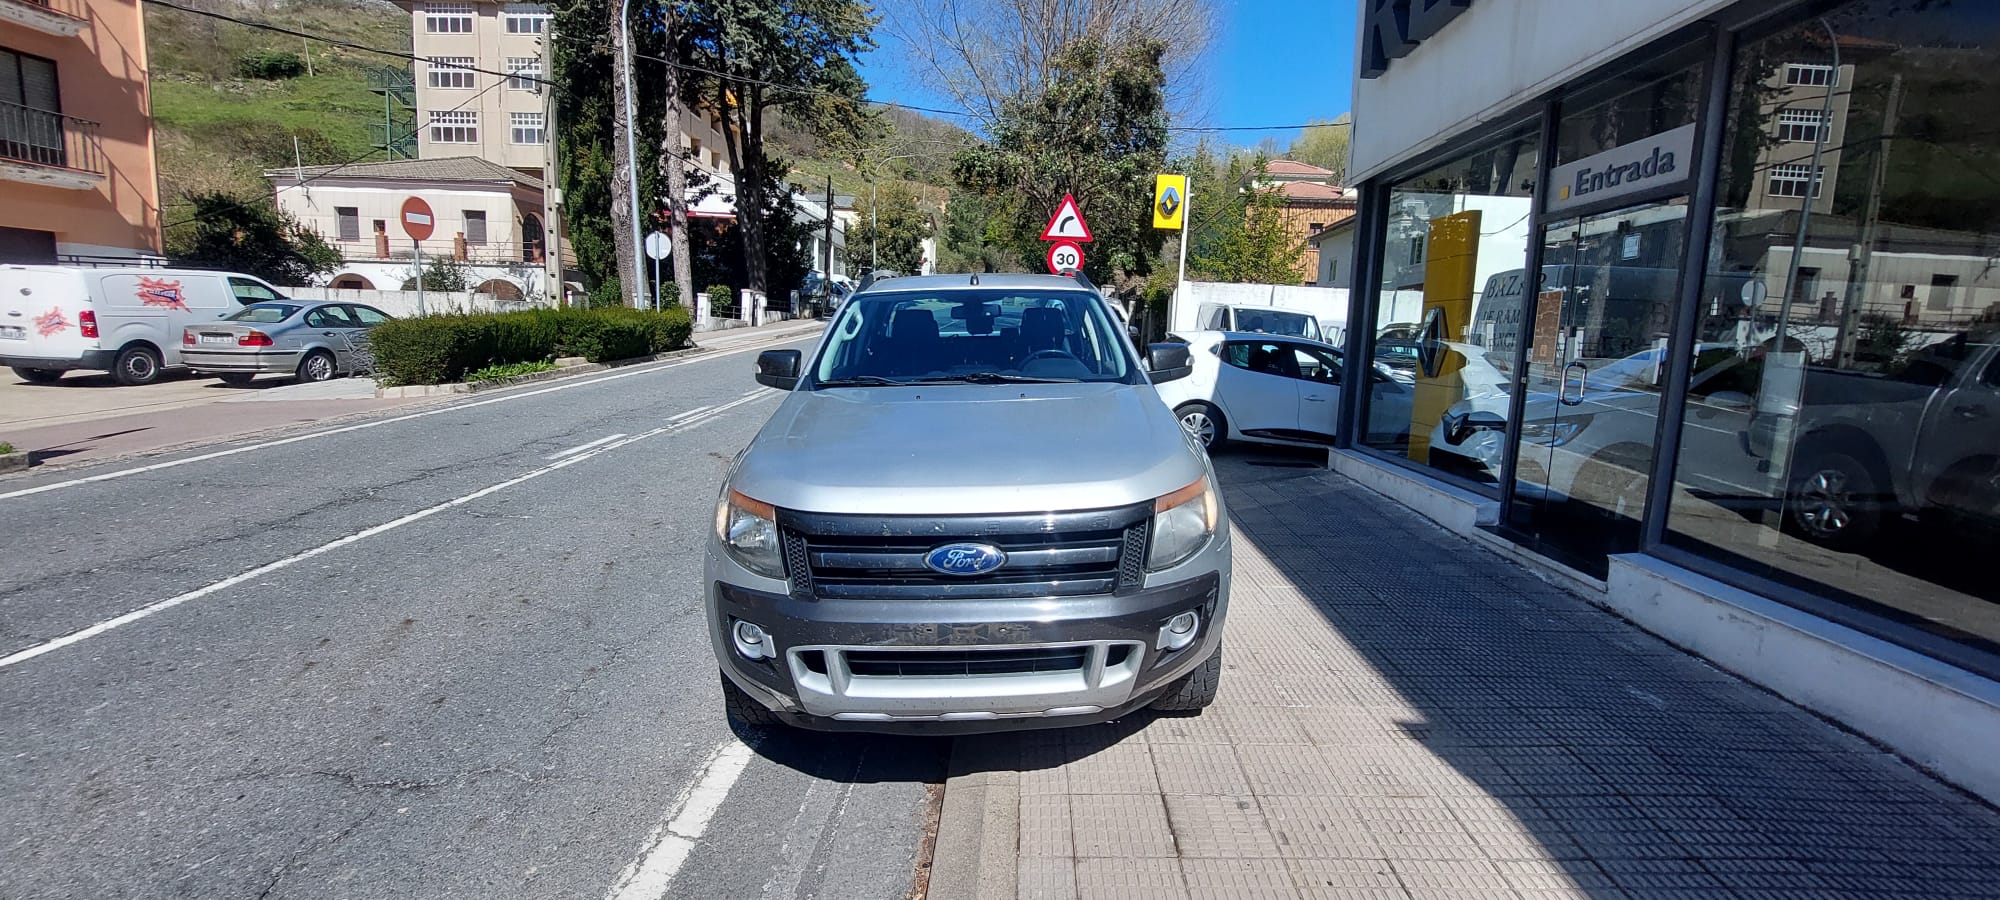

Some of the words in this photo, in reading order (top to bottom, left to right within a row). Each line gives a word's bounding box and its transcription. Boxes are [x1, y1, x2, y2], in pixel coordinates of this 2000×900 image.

[1574, 147, 1676, 196] Entrada
[1056, 253, 1076, 266] 30
[944, 549, 987, 570] Ford
